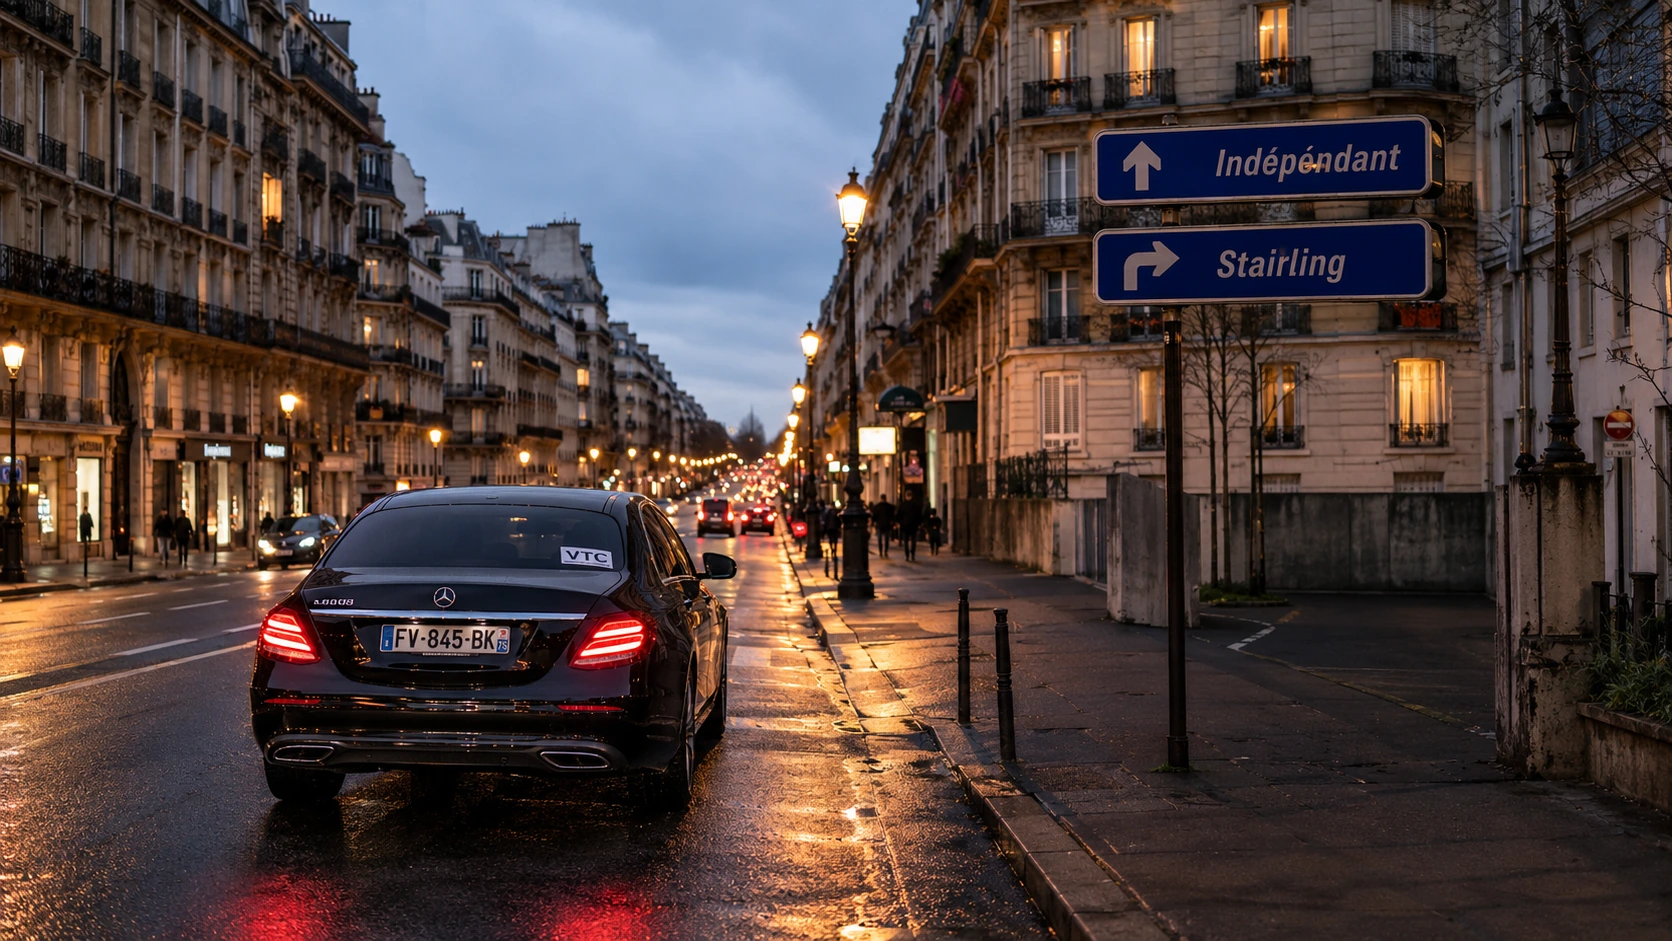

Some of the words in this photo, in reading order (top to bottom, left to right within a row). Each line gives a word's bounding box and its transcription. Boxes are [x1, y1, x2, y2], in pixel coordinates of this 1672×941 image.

[1215, 143, 1402, 183] Indépéndant
[1216, 247, 1347, 284] Stairling
[565, 550, 608, 563] VTC
[394, 628, 496, 650] FV-845-BK
